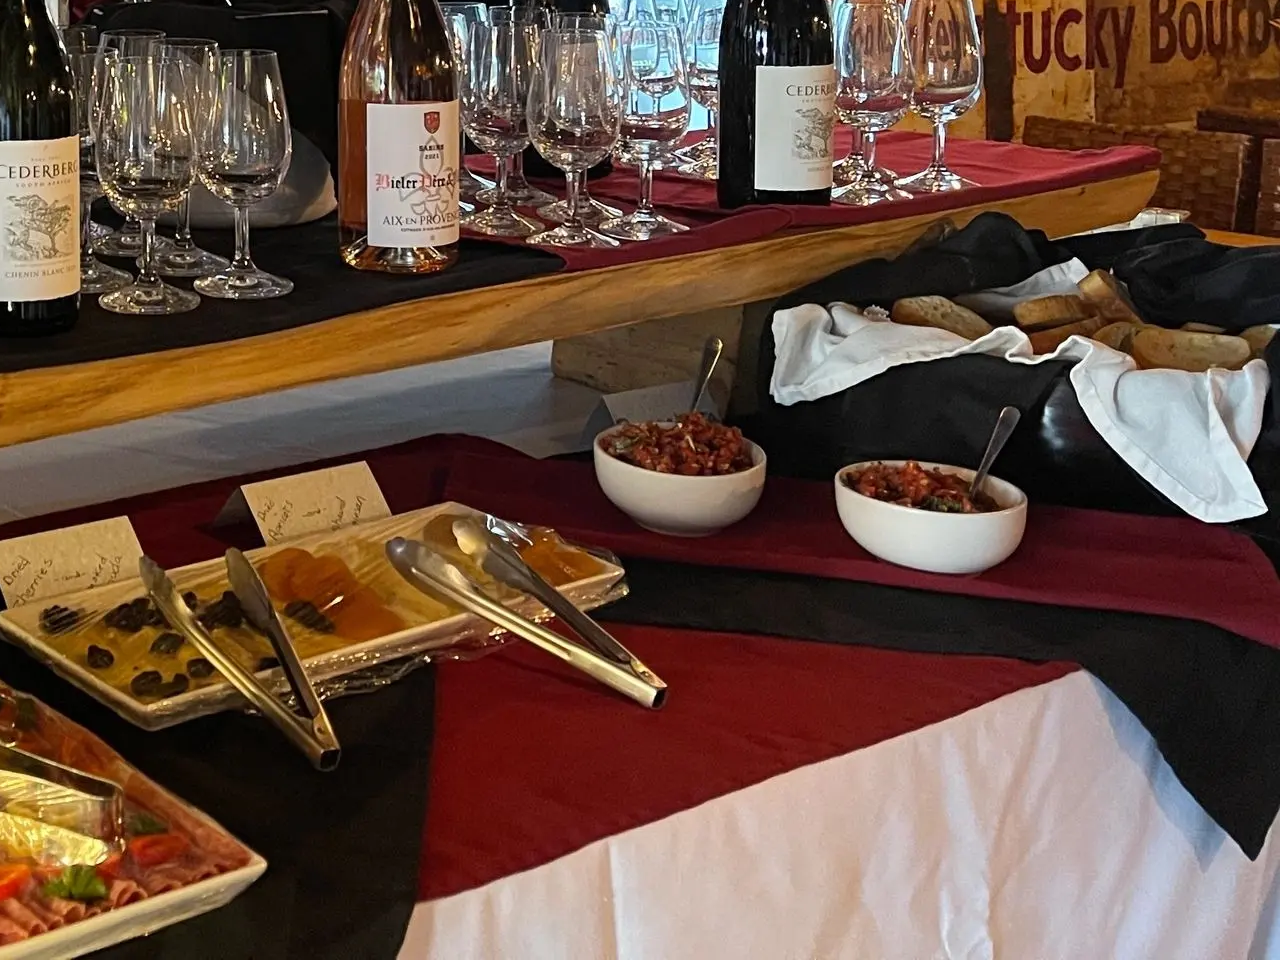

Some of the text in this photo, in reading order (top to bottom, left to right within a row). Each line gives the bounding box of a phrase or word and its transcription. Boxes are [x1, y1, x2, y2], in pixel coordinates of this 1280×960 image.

[375, 173, 418, 192] Bieler
[382, 215, 403, 226] AIX
[405, 217, 418, 225] EN
[5, 271, 40, 280] CHENIN
[2, 555, 32, 587] Dried
